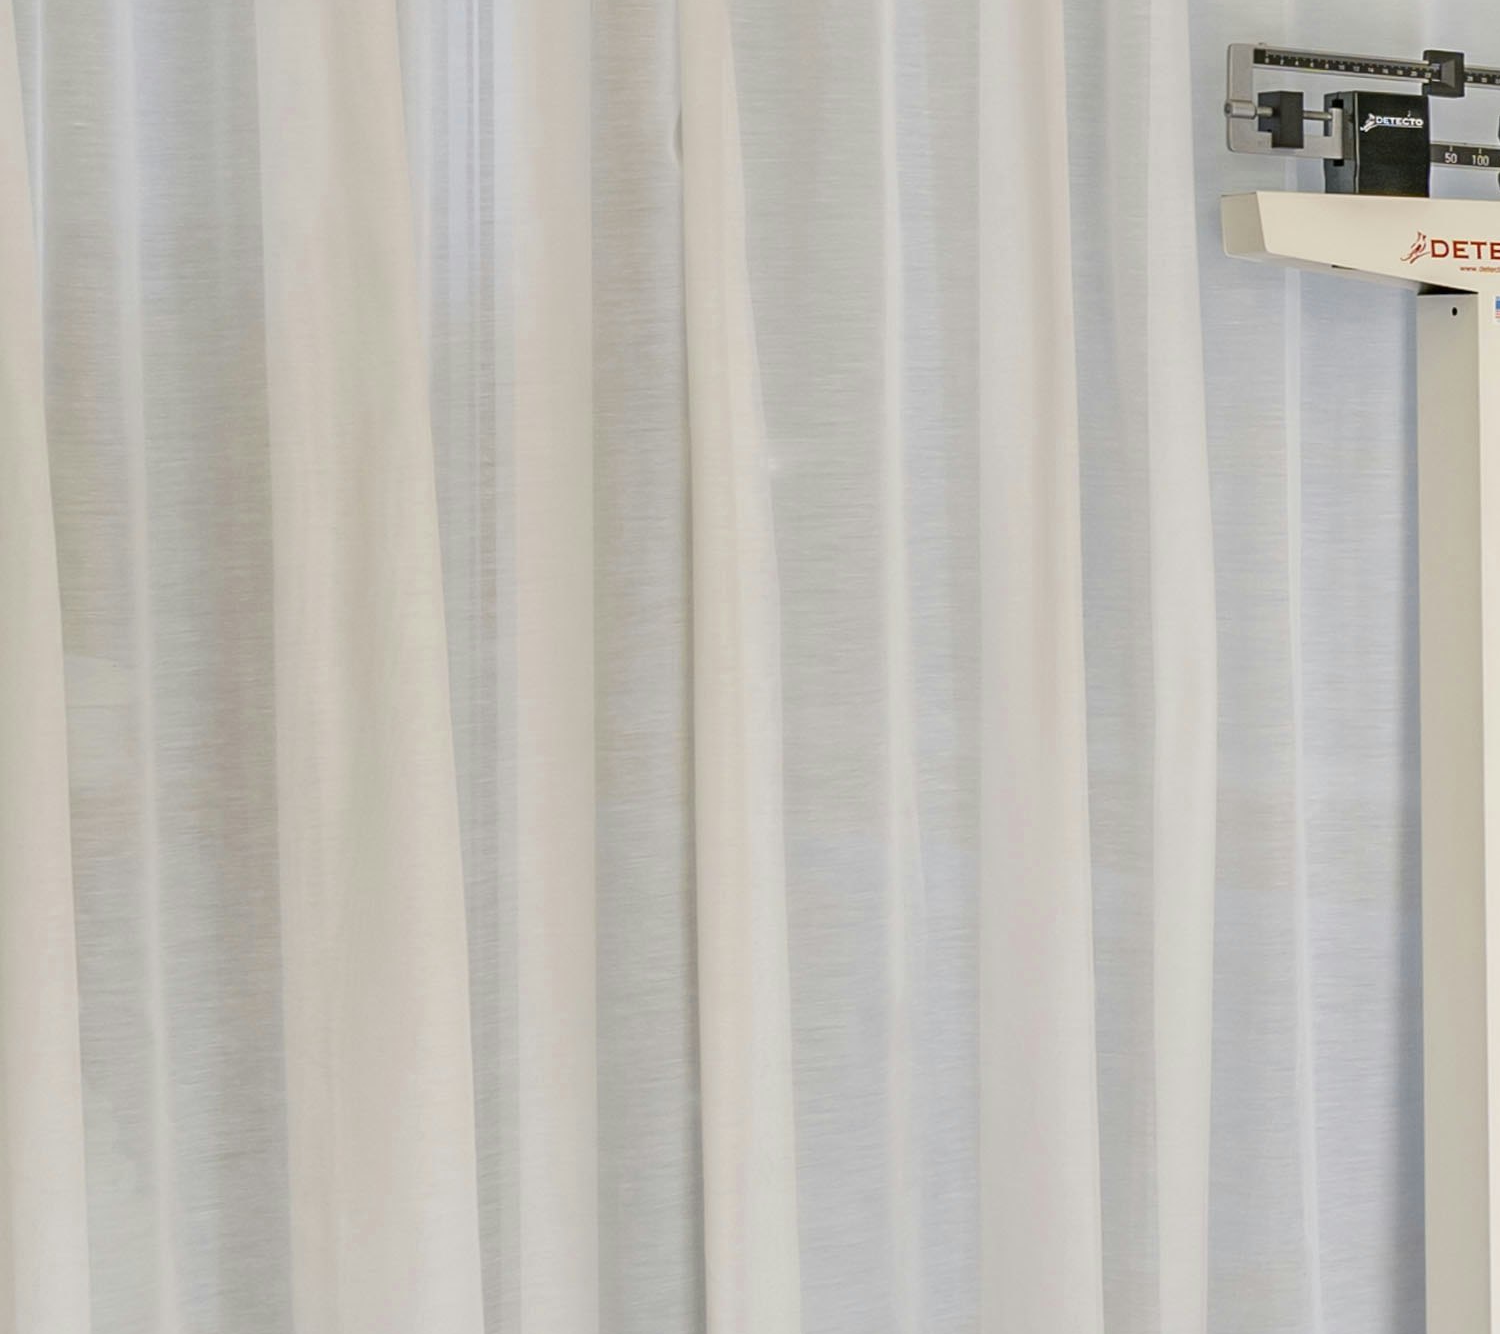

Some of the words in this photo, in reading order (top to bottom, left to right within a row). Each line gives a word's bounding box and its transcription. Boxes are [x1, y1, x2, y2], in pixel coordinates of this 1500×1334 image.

[1376, 115, 1424, 126] DETECTO
[1444, 152, 1457, 164] 50
[1472, 154, 1490, 166] 100
